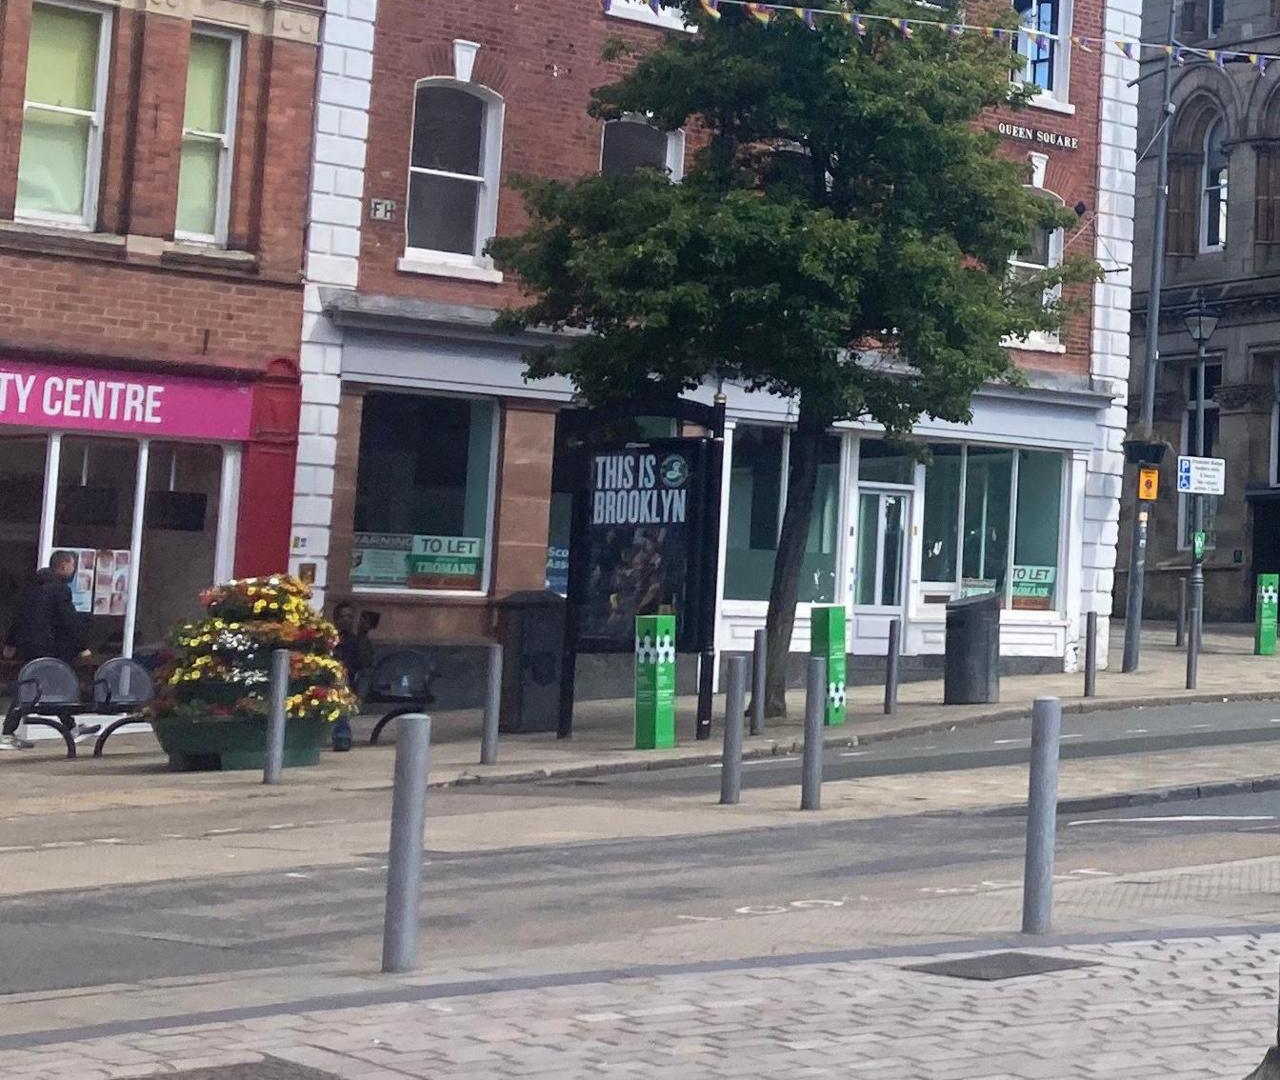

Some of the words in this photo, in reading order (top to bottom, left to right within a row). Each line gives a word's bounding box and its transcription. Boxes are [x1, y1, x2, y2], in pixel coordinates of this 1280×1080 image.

[998, 122, 1033, 140] QUEEN
[1036, 130, 1078, 149] SQUARE
[42, 376, 165, 423] CENTRE
[595, 454, 635, 489] THIS
[638, 454, 656, 488] IS
[593, 489, 686, 524] BROOKLYN
[421, 538, 442, 553] TO
[447, 539, 477, 554] LET
[1012, 568, 1026, 579] TO
[1029, 568, 1050, 580] LET
